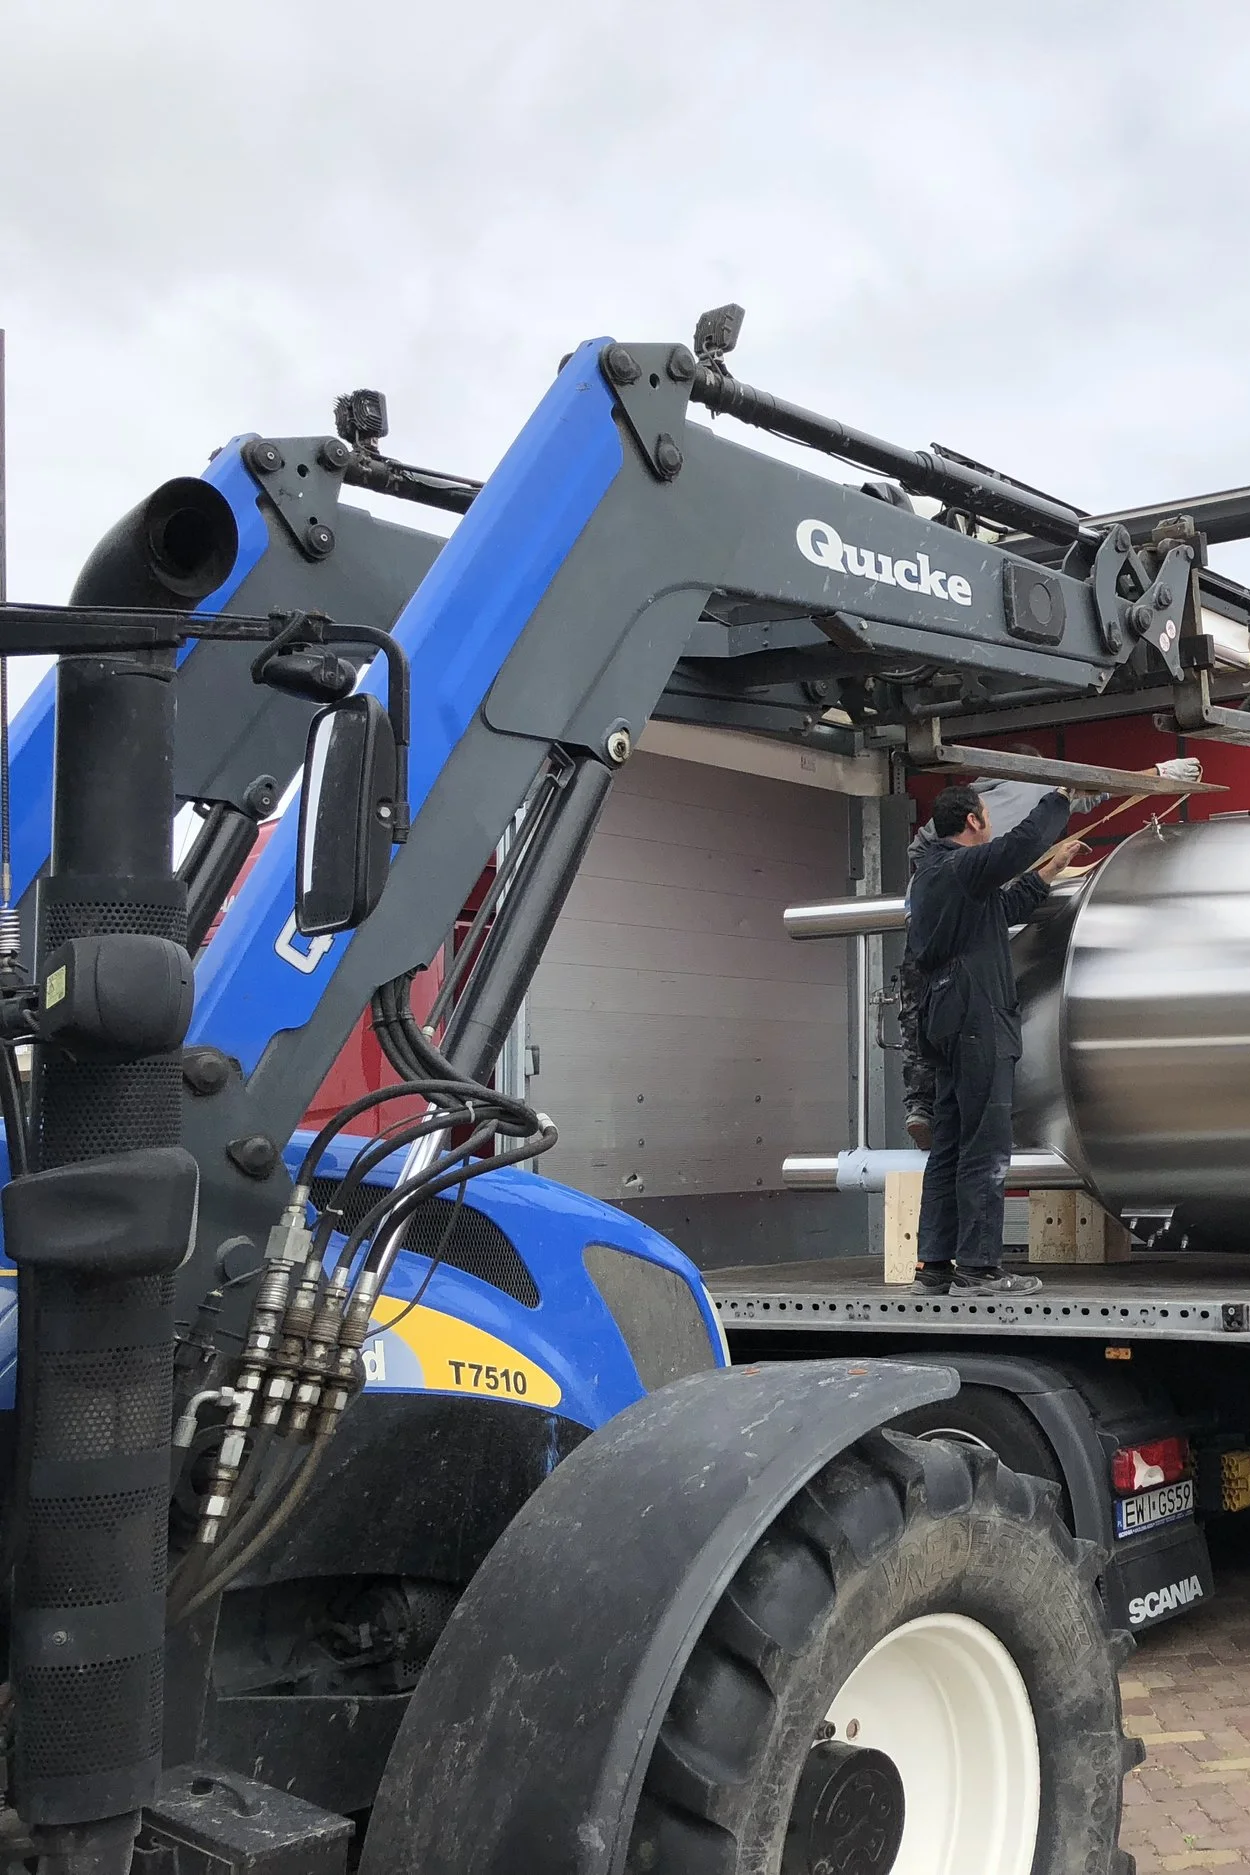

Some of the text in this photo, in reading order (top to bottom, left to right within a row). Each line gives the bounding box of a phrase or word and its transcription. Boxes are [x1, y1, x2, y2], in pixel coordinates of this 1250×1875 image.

[796, 519, 972, 606] Quicke
[448, 1360, 527, 1395] T7510
[1125, 1495, 1152, 1528] EWI
[1158, 1484, 1191, 1516] GS59
[1129, 1575, 1203, 1624] SCANIA
